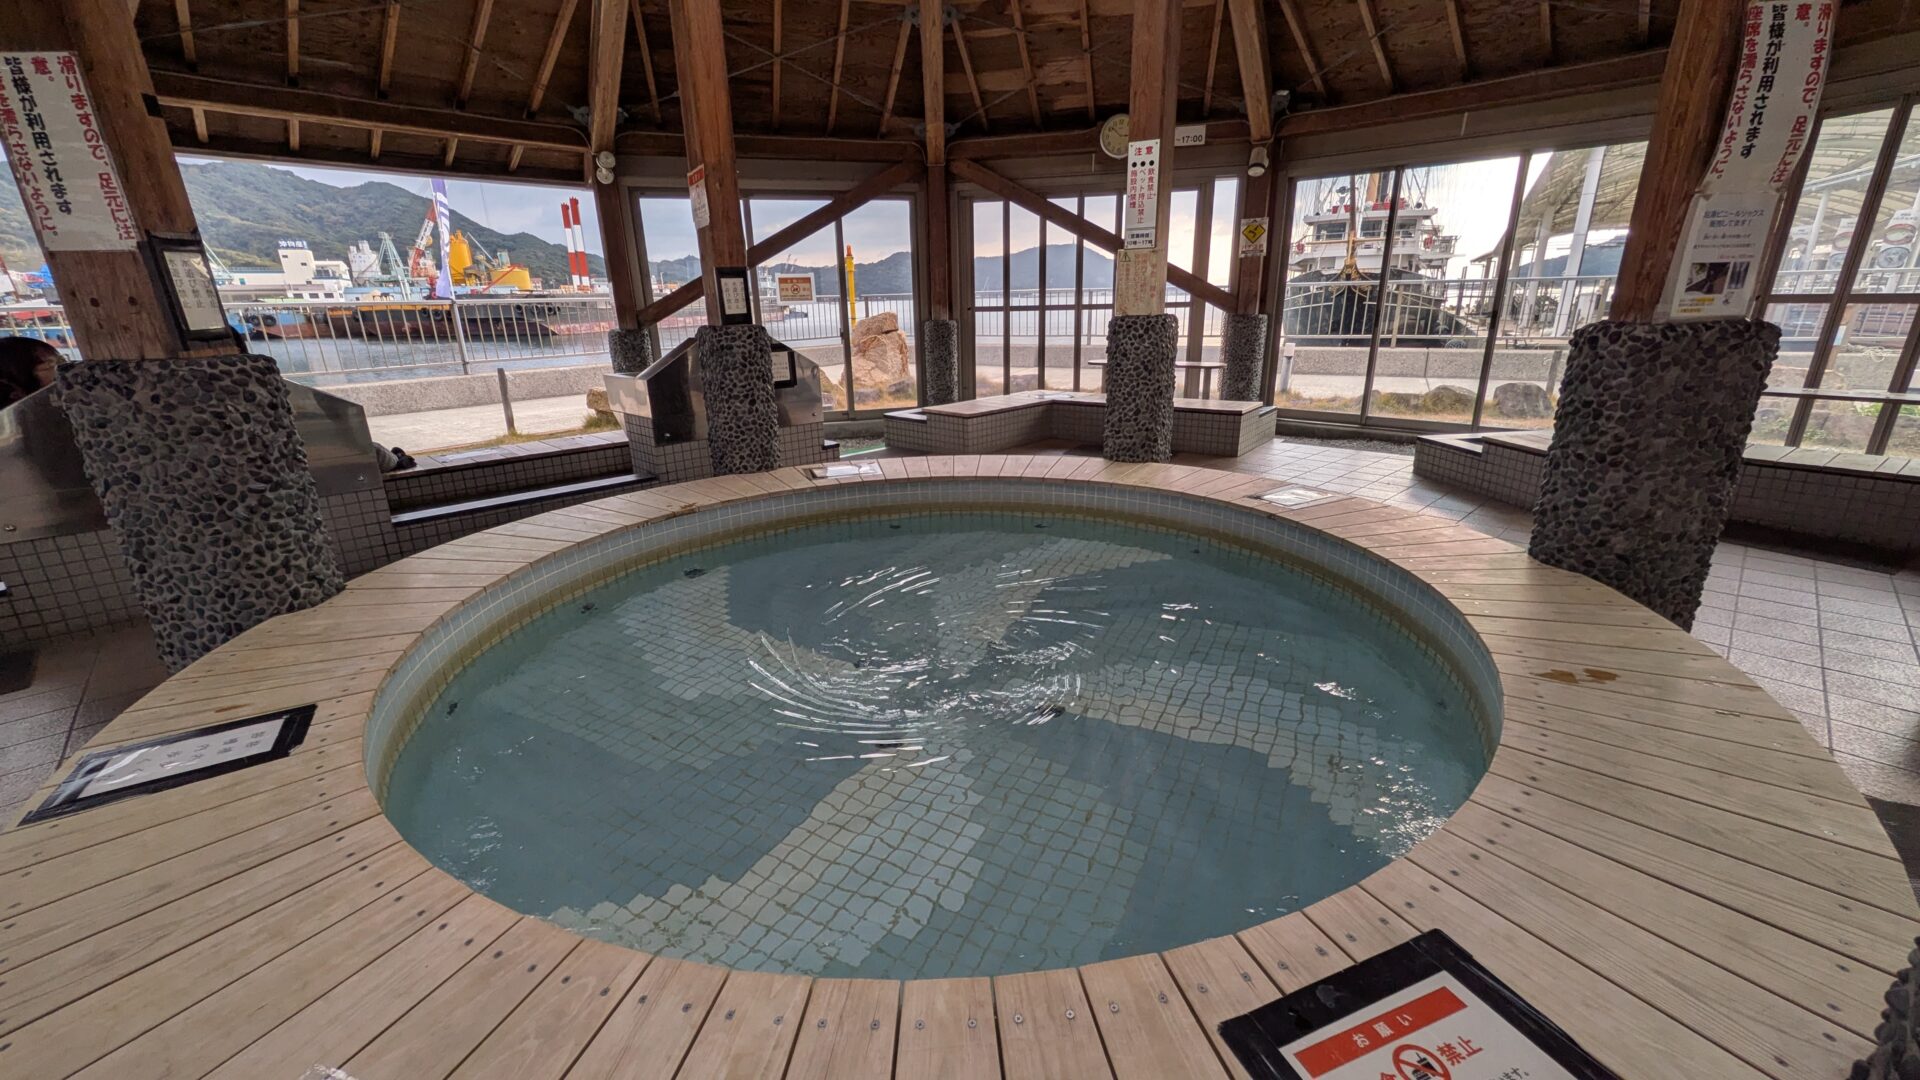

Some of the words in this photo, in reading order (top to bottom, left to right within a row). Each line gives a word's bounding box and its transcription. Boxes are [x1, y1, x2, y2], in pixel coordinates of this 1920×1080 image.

[1795, 3, 1812, 27] 意。
[31, 56, 54, 82] 意。
[1740, 4, 1789, 160] 皆様が利用されます
[1709, 5, 1764, 180] 座席を濡らさないように。
[3, 56, 72, 216] 皆様が利用されます
[1134, 146, 1154, 156] 注意
[1352, 1014, 1413, 1048] お願い
[1436, 1035, 1484, 1066] 禁止
